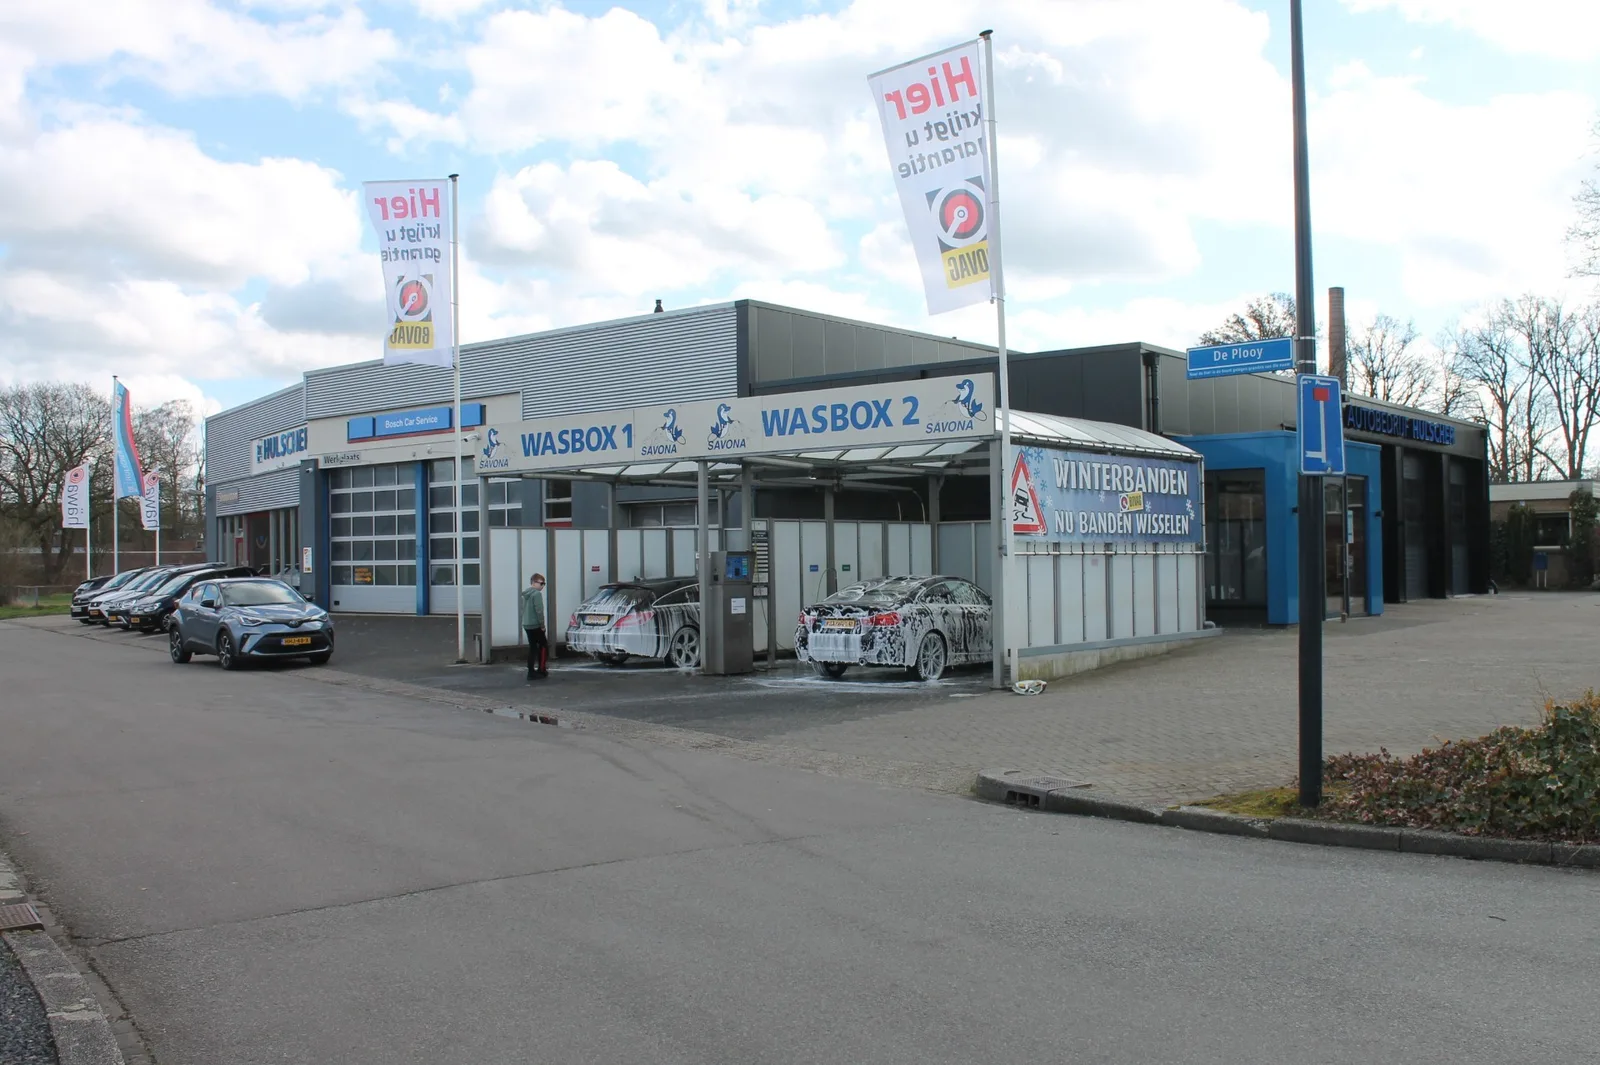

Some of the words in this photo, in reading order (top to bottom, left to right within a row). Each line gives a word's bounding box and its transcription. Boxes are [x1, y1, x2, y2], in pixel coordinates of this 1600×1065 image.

[1213, 351, 1228, 361] De
[1231, 347, 1263, 360] Plooy
[385, 420, 403, 429] Bosch
[404, 417, 415, 427] Car
[416, 415, 438, 425] Service
[761, 399, 893, 437] WASBOX
[902, 396, 920, 426] 2
[925, 420, 974, 434] SAVONA
[1412, 418, 1455, 445] HULSCHER
[521, 425, 617, 457] WASBOX
[622, 423, 633, 448] 1
[707, 438, 746, 450] SAVONA
[641, 443, 677, 456] SAVONA
[479, 458, 509, 469] SAVONA
[1053, 458, 1188, 496] WINTERBANDEN
[1054, 510, 1074, 534] NU
[1079, 511, 1132, 534] BANDEN
[1135, 513, 1189, 535] WISSELEN
